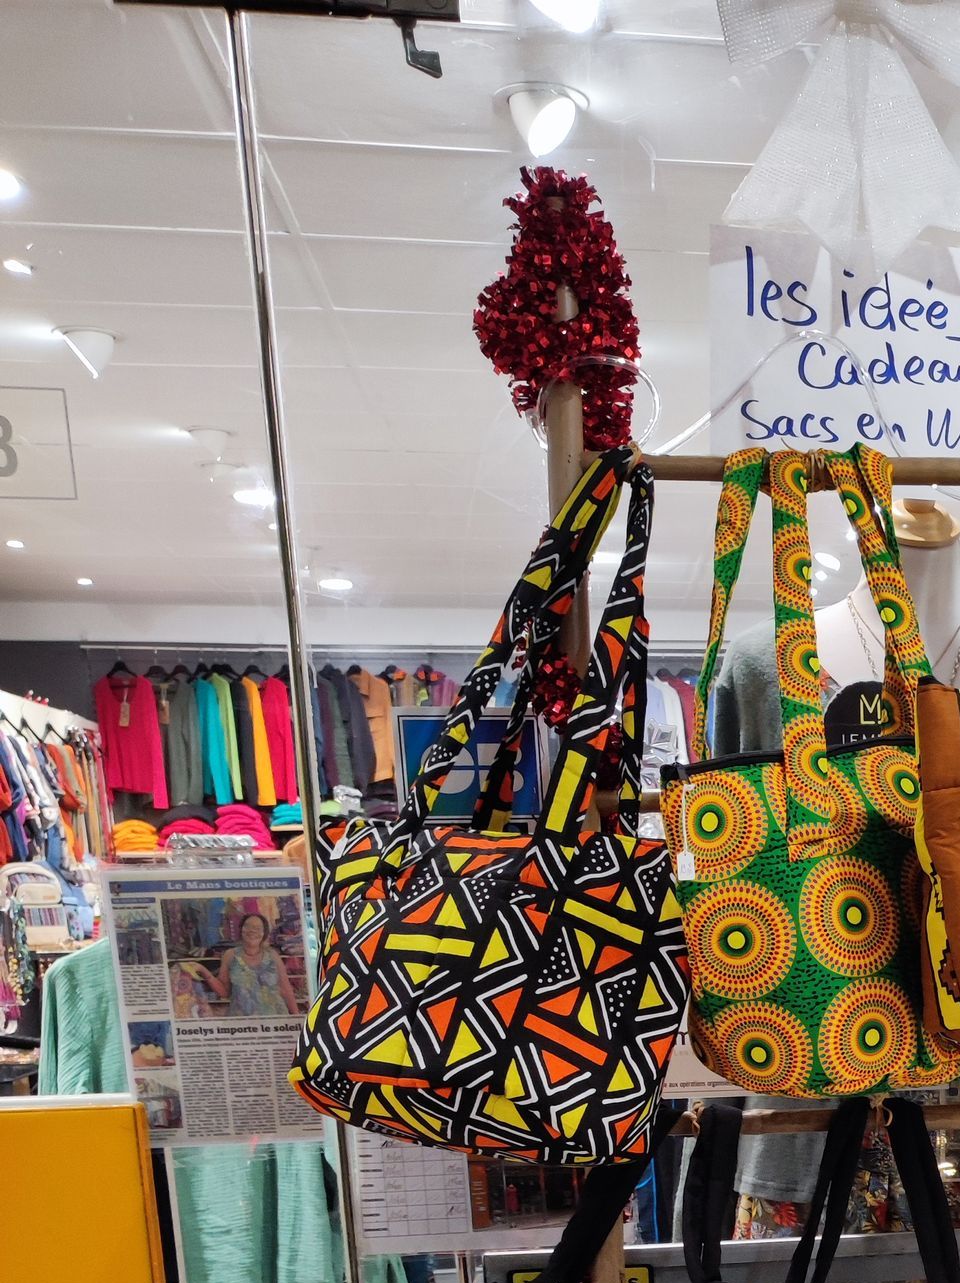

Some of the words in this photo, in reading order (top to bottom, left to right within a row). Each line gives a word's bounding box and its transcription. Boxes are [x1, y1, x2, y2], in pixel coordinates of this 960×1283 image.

[740, 399, 839, 444] Sacs
[856, 412, 907, 443] en
[167, 881, 182, 890] Le
[185, 881, 221, 890] Mans
[224, 879, 289, 890] boutiques
[176, 1026, 214, 1036] Joselys
[217, 1025, 258, 1035] importe
[260, 1024, 271, 1033] le
[273, 1023, 302, 1033] soleil
